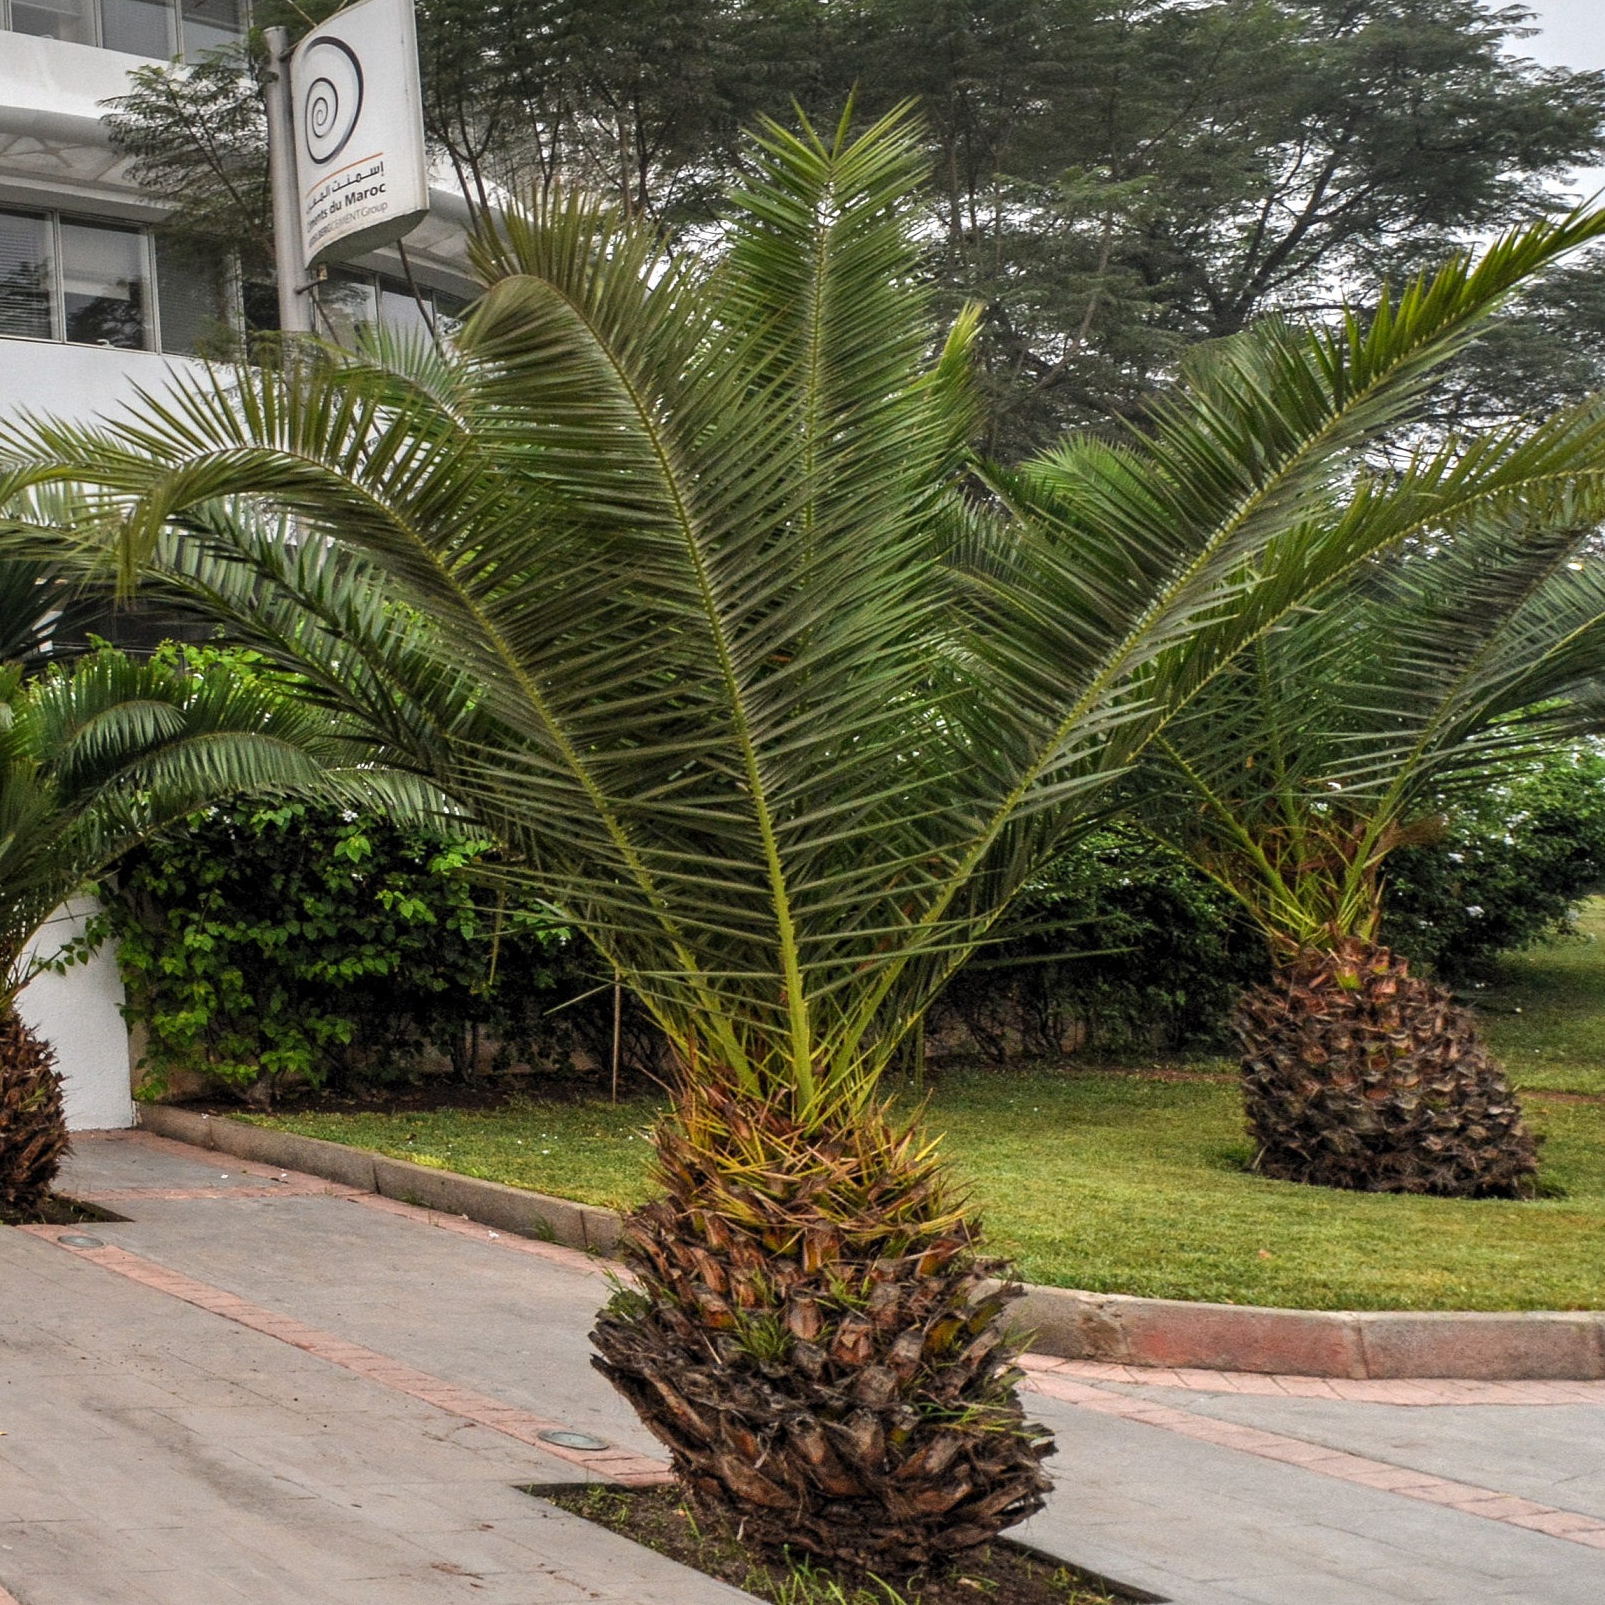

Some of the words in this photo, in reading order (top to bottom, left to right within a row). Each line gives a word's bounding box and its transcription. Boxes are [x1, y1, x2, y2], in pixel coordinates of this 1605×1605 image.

[330, 200, 342, 214] du
[345, 183, 386, 207] Maroc
[361, 201, 388, 216] Group
